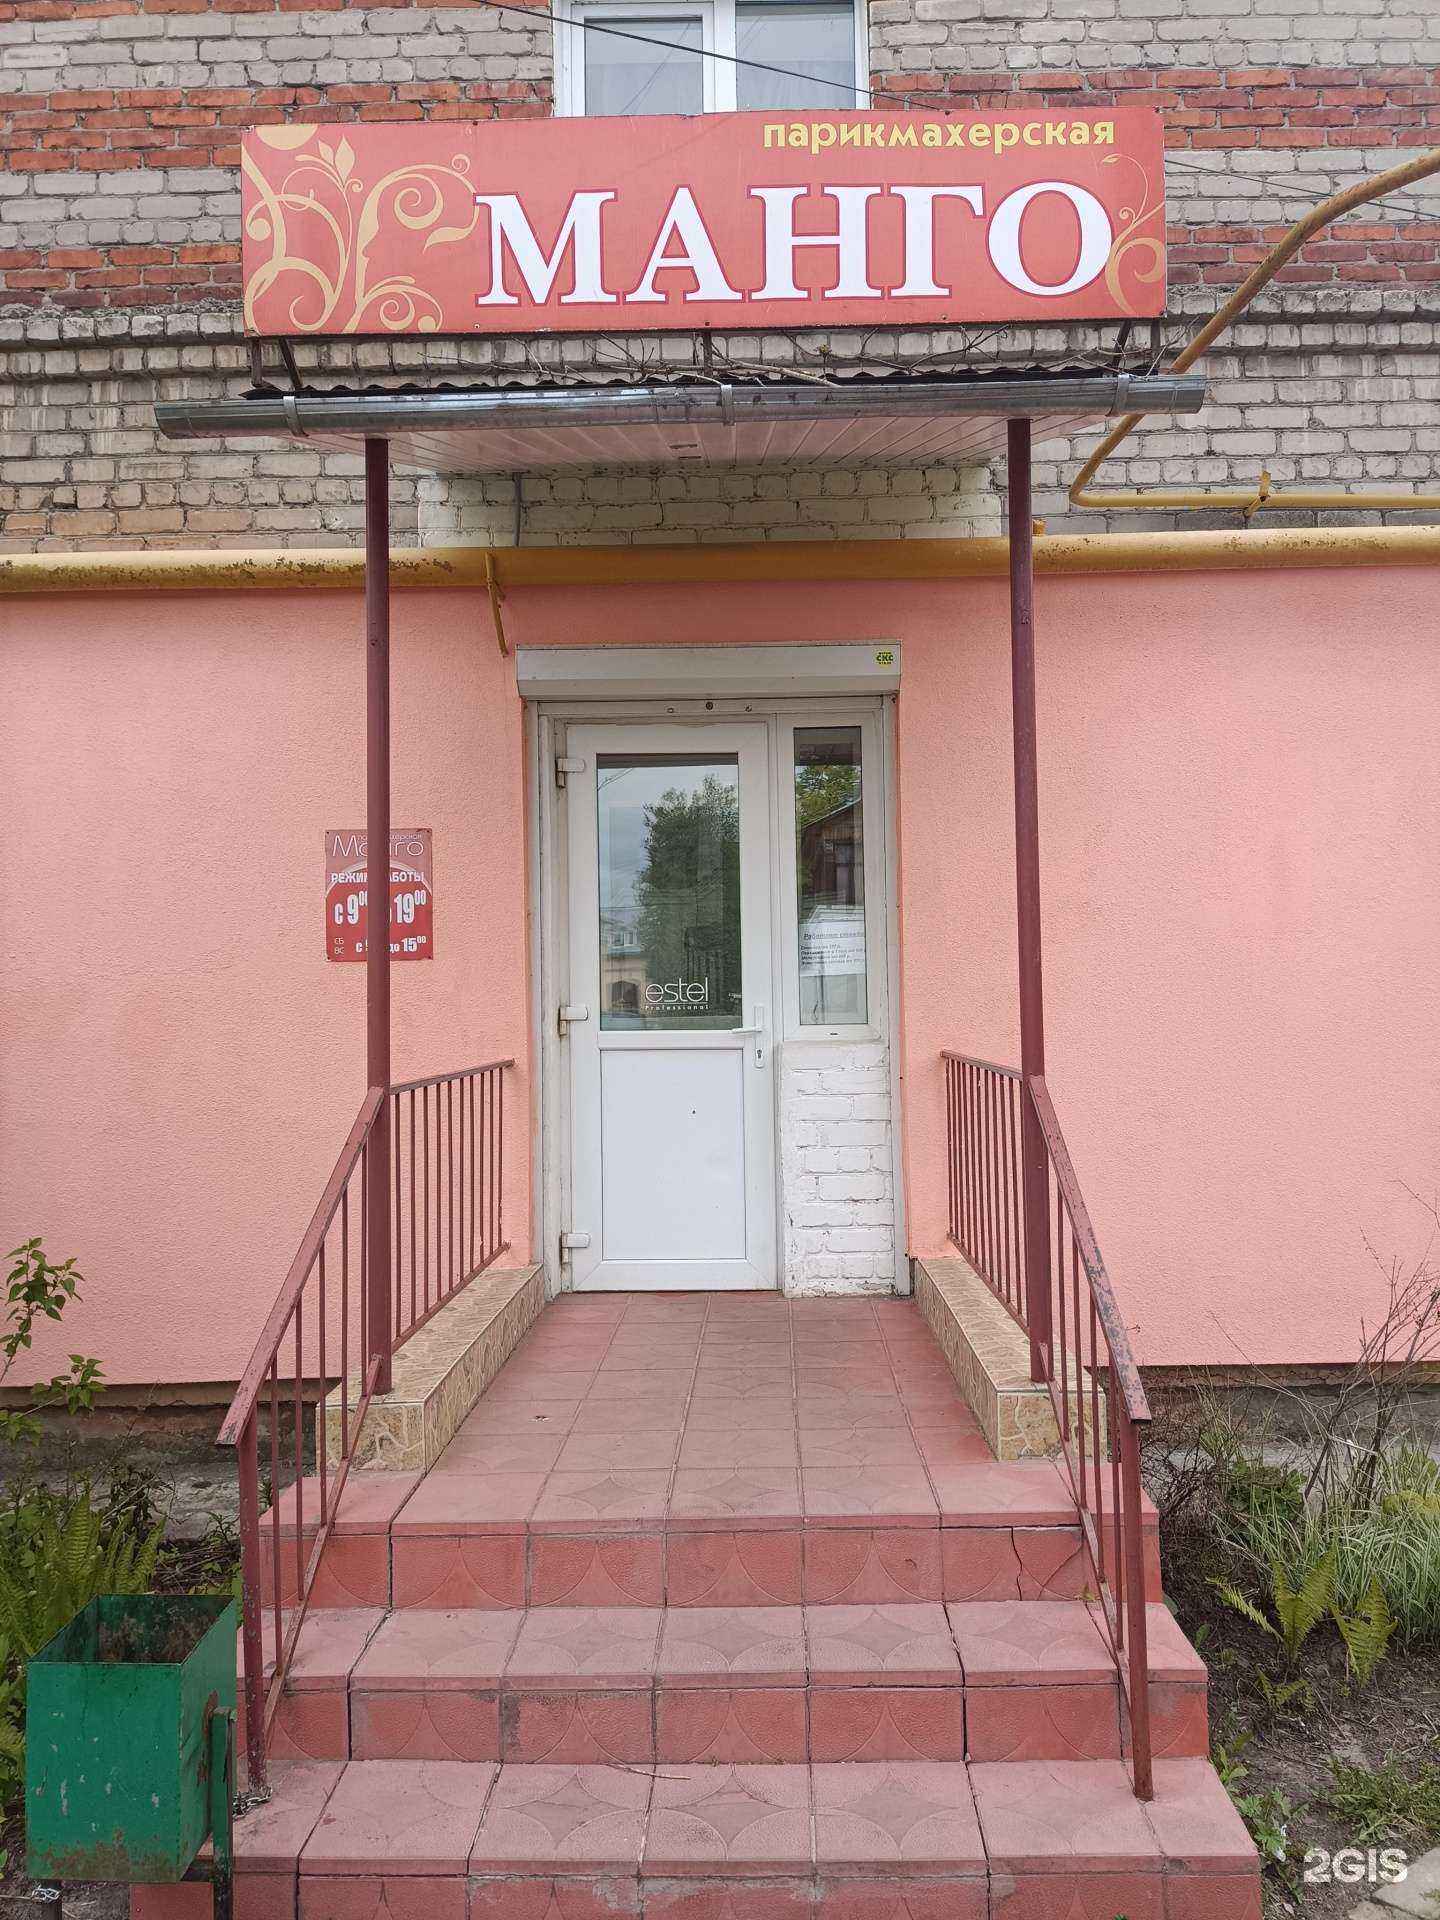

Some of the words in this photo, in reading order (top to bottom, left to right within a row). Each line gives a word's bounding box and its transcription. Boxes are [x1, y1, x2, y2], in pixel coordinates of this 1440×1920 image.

[763, 121, 1115, 154] парикмахерская
[474, 181, 1113, 305] МАНГО
[390, 871, 424, 882] БОТЫ
[645, 977, 709, 1003] estel
